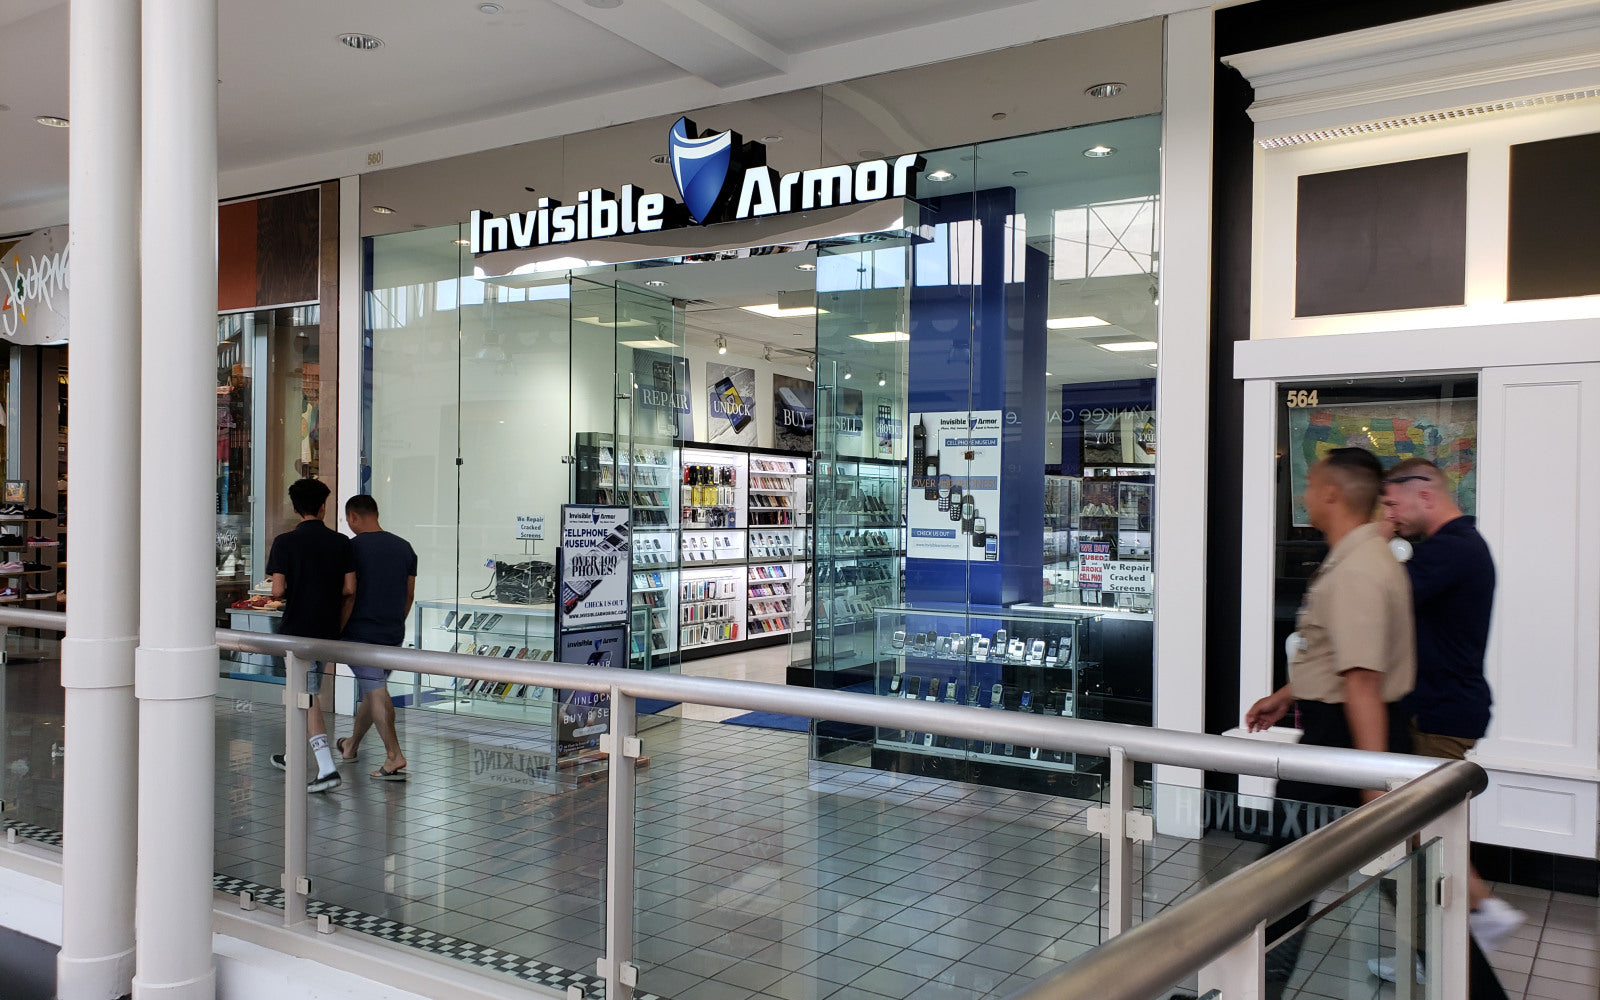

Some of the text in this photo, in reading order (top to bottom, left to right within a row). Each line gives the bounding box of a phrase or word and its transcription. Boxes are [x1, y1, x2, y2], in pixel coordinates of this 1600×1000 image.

[470, 154, 918, 254] Invisible Armor
[643, 389, 689, 410] REPAIR
[1286, 389, 1319, 408] 564
[713, 400, 751, 416] UNLOCK
[783, 408, 808, 428] BUY
[836, 415, 858, 433] SELL
[912, 478, 936, 488] OVER
[1081, 544, 1110, 553] WE BUY
[572, 556, 597, 567] OVER
[571, 564, 617, 577] PHONES!
[1102, 563, 1150, 572] We Repair
[1080, 573, 1091, 581] CELL
[1109, 573, 1146, 582] Cracked
[1109, 583, 1146, 592] Screens
[584, 601, 604, 609] CHECK
[611, 599, 624, 607] OUT
[567, 640, 593, 648] Invisible
[563, 713, 583, 724] BUY
